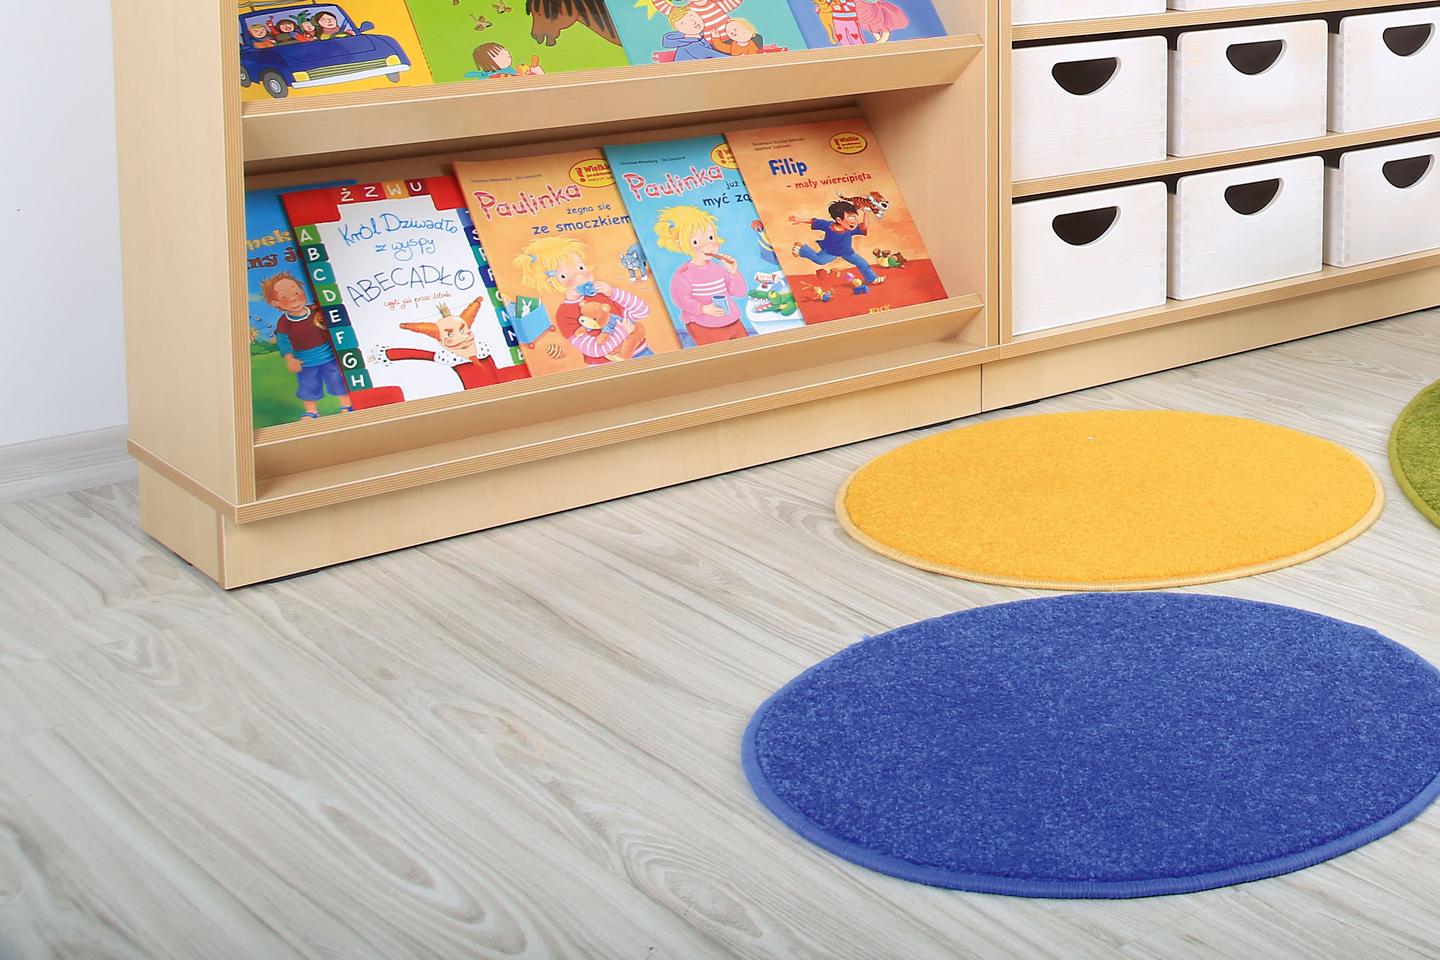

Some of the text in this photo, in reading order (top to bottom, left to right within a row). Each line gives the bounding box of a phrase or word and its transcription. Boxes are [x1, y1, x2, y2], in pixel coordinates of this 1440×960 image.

[768, 157, 808, 176] Filip
[410, 181, 422, 192] U
[622, 165, 723, 201] Paulinka
[795, 178, 817, 190] mały
[820, 171, 872, 186] wiercipięta
[341, 188, 354, 202] Ż
[364, 186, 378, 197] Z
[387, 184, 402, 196] W
[474, 184, 581, 220] Paulinka
[597, 201, 612, 212] się
[703, 192, 730, 208] myć
[380, 212, 458, 234] Dziwadło
[532, 214, 631, 236] ze smoczkiem
[301, 228, 313, 243] A
[307, 247, 320, 261] B
[392, 237, 436, 262] wyspy
[313, 268, 326, 281] C
[346, 264, 475, 307] ABECADŁO
[322, 290, 336, 302] D
[329, 309, 341, 323] E
[336, 331, 345, 345] F
[343, 352, 358, 369] G
[351, 374, 365, 387] H
